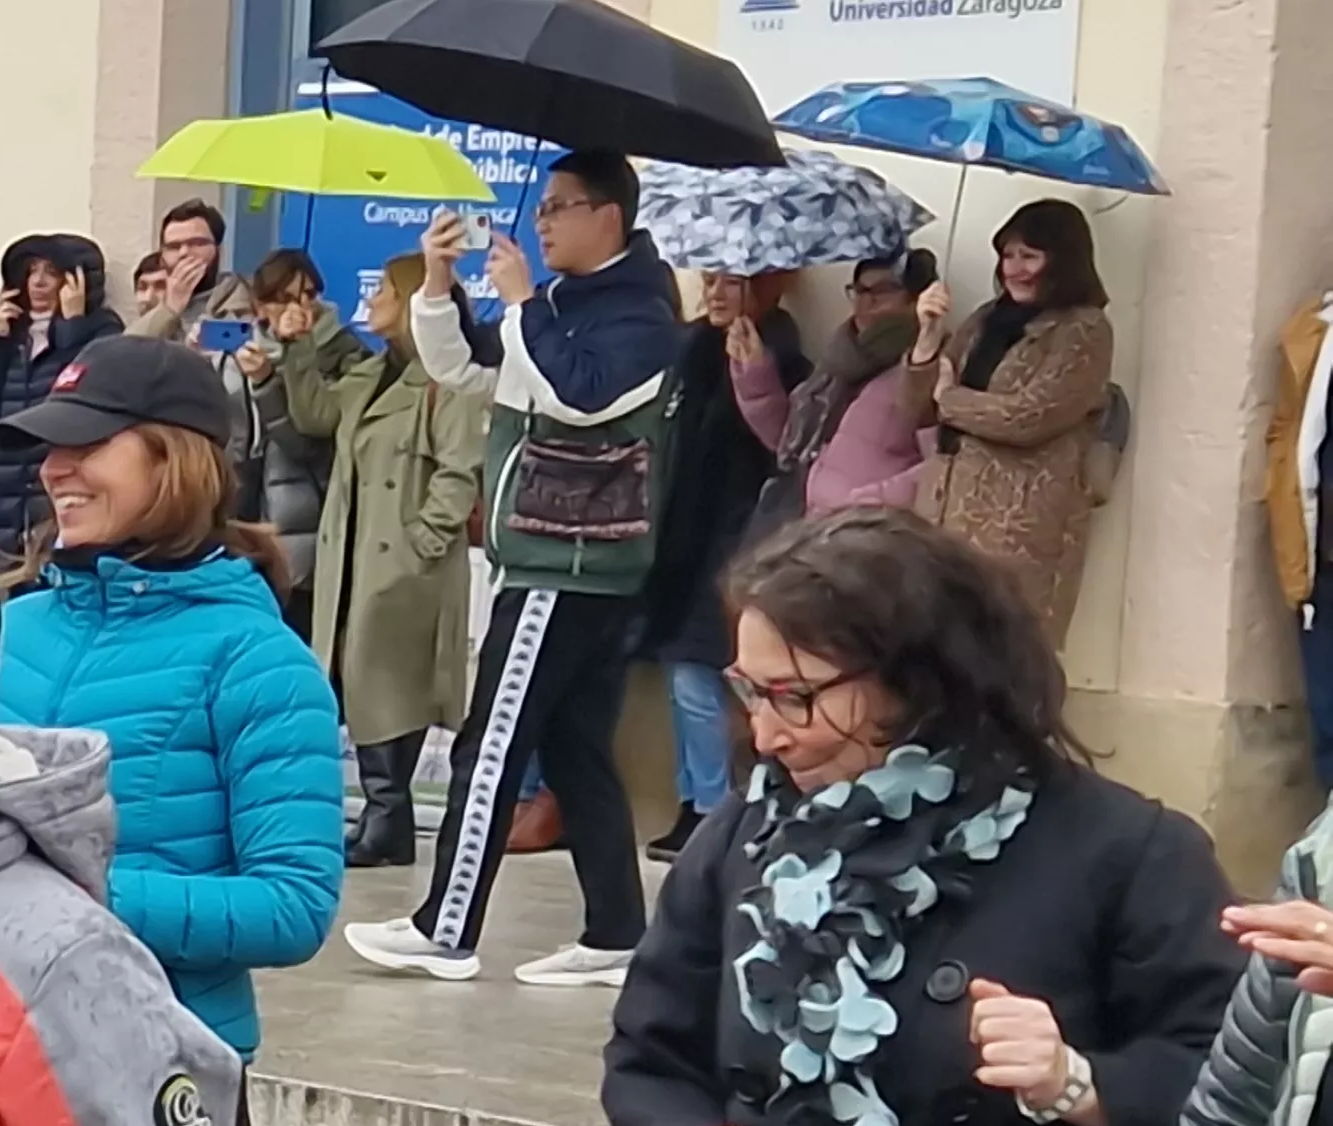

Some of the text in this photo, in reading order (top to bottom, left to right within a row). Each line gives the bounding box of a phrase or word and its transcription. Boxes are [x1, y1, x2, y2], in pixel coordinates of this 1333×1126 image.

[830, 0, 1062, 21] Universidad Zaragoza
[467, 123, 562, 158] Empre
[472, 156, 538, 183] ública
[364, 201, 430, 228] Campus
